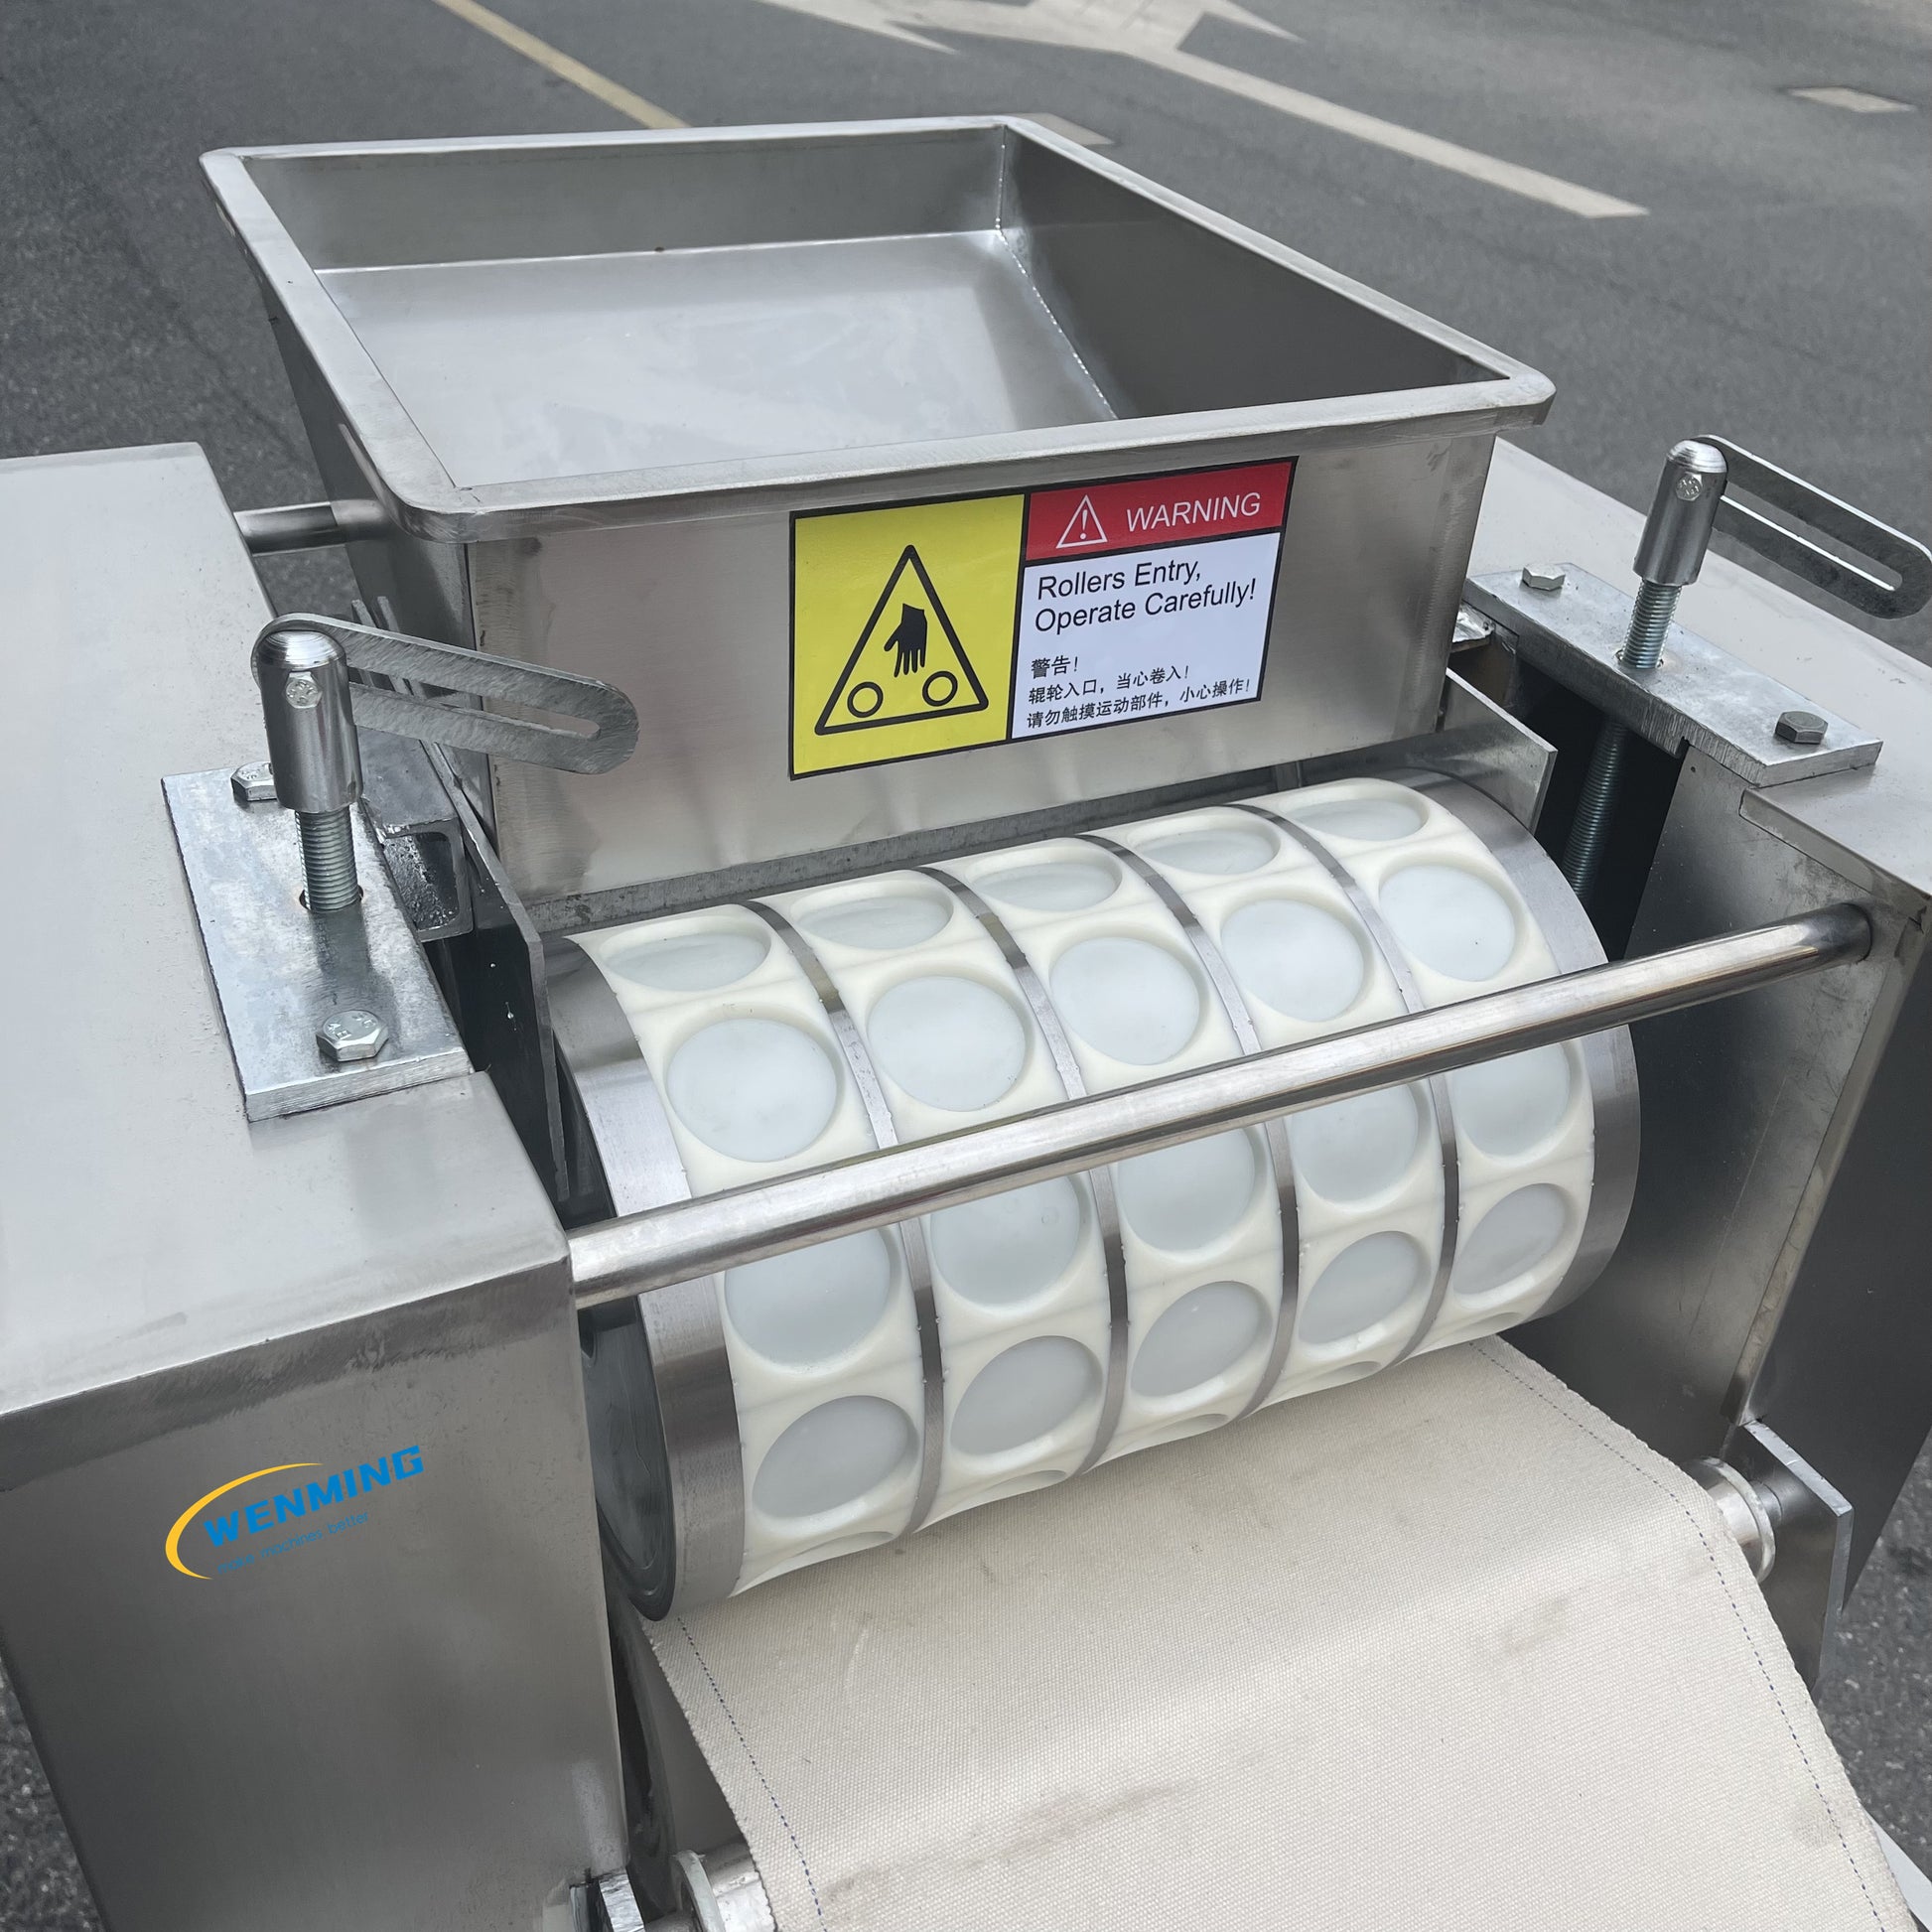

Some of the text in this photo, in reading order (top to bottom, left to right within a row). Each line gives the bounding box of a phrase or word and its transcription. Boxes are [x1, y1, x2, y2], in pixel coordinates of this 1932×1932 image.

[1127, 492, 1261, 532] WARNING
[1037, 560, 1201, 600] Rollers Entry,
[1035, 578, 1256, 635] Operate Carefully!
[1031, 655, 1078, 679] 警告！
